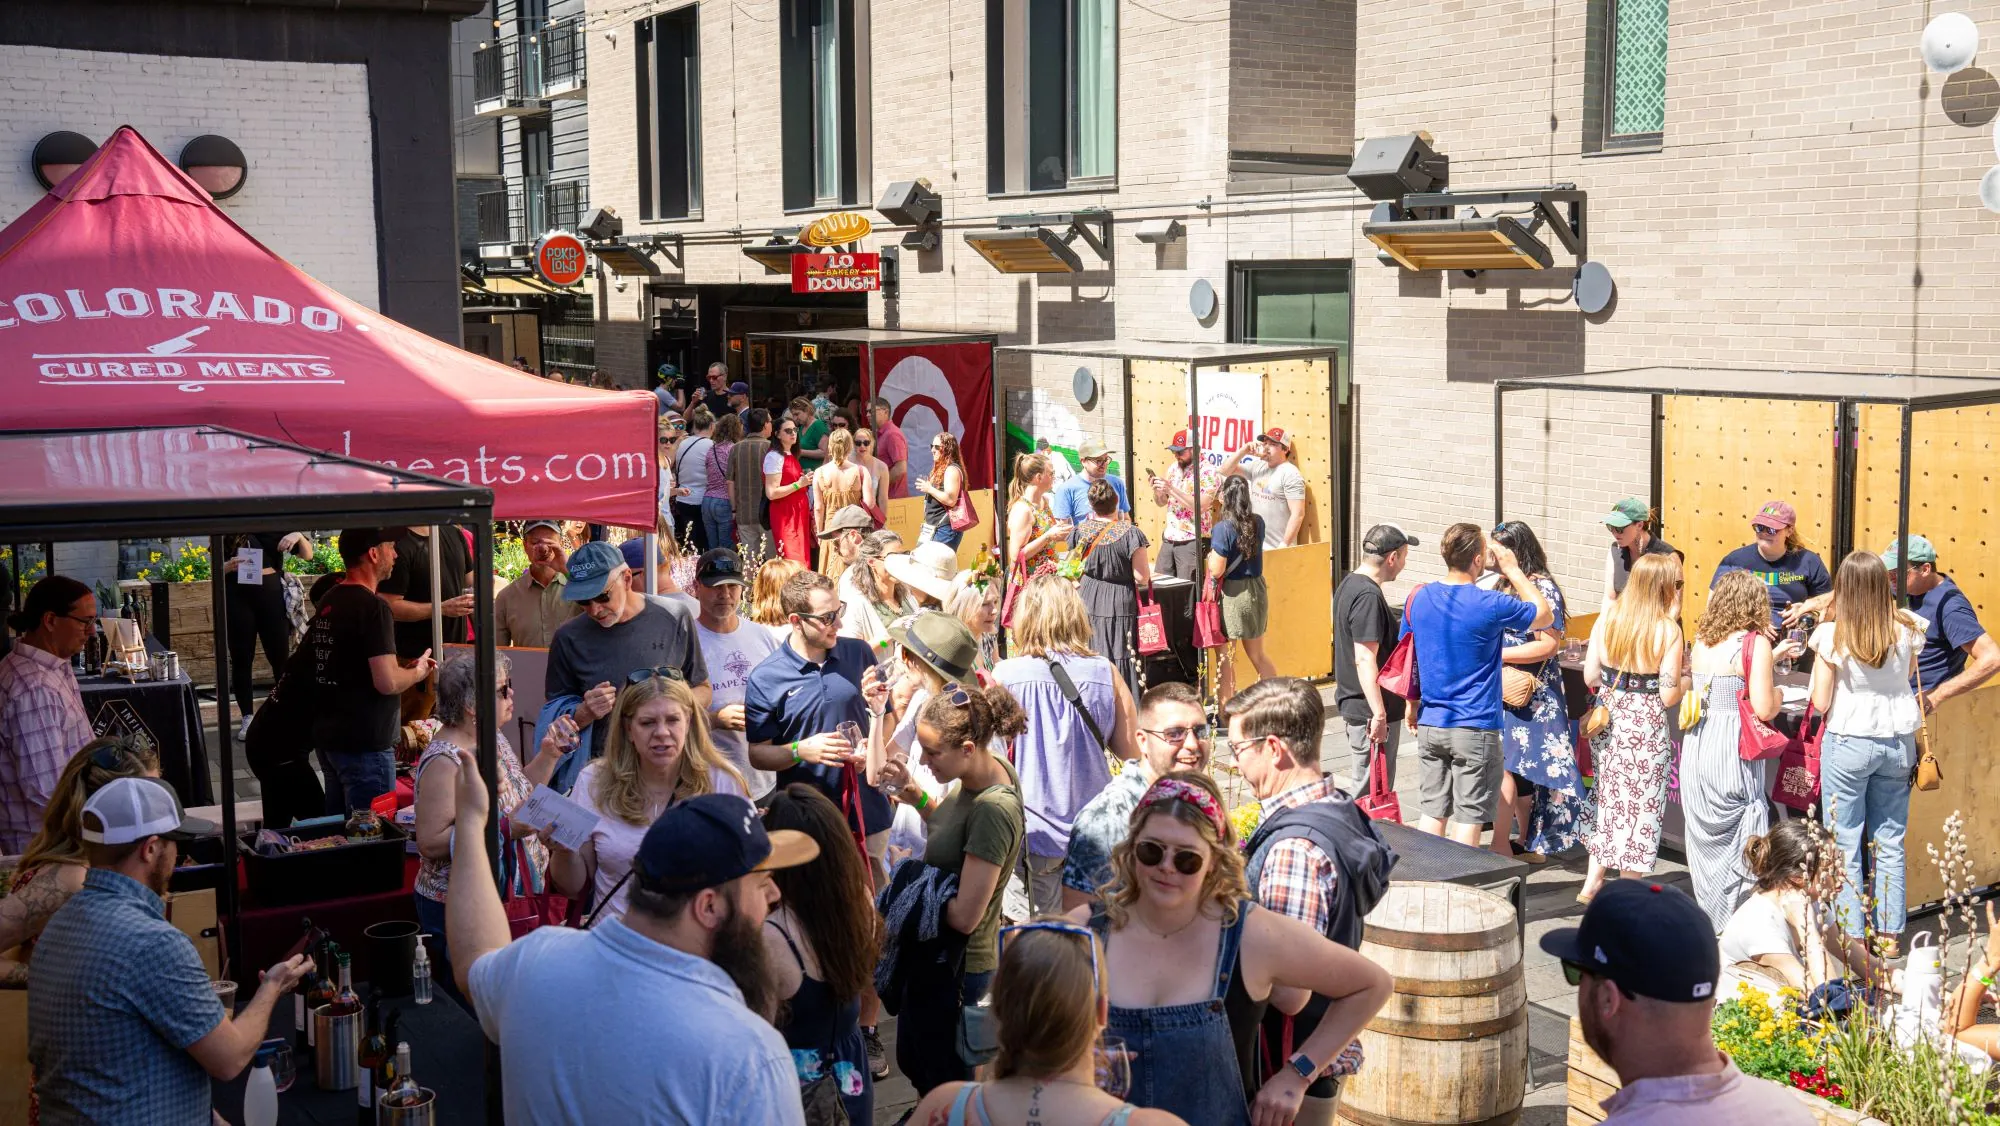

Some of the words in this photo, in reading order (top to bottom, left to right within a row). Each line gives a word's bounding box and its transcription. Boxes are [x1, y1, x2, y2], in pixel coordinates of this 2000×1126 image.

[546, 247, 581, 261] POKA
[552, 258, 577, 274] LOLA
[828, 254, 855, 270] LO
[826, 268, 860, 276] BAKERY
[807, 276, 876, 291] DOUGH
[39, 362, 187, 378] CURED
[198, 361, 335, 378] MEATS
[1224, 418, 1254, 453] ON
[712, 679, 740, 690] RAPE
